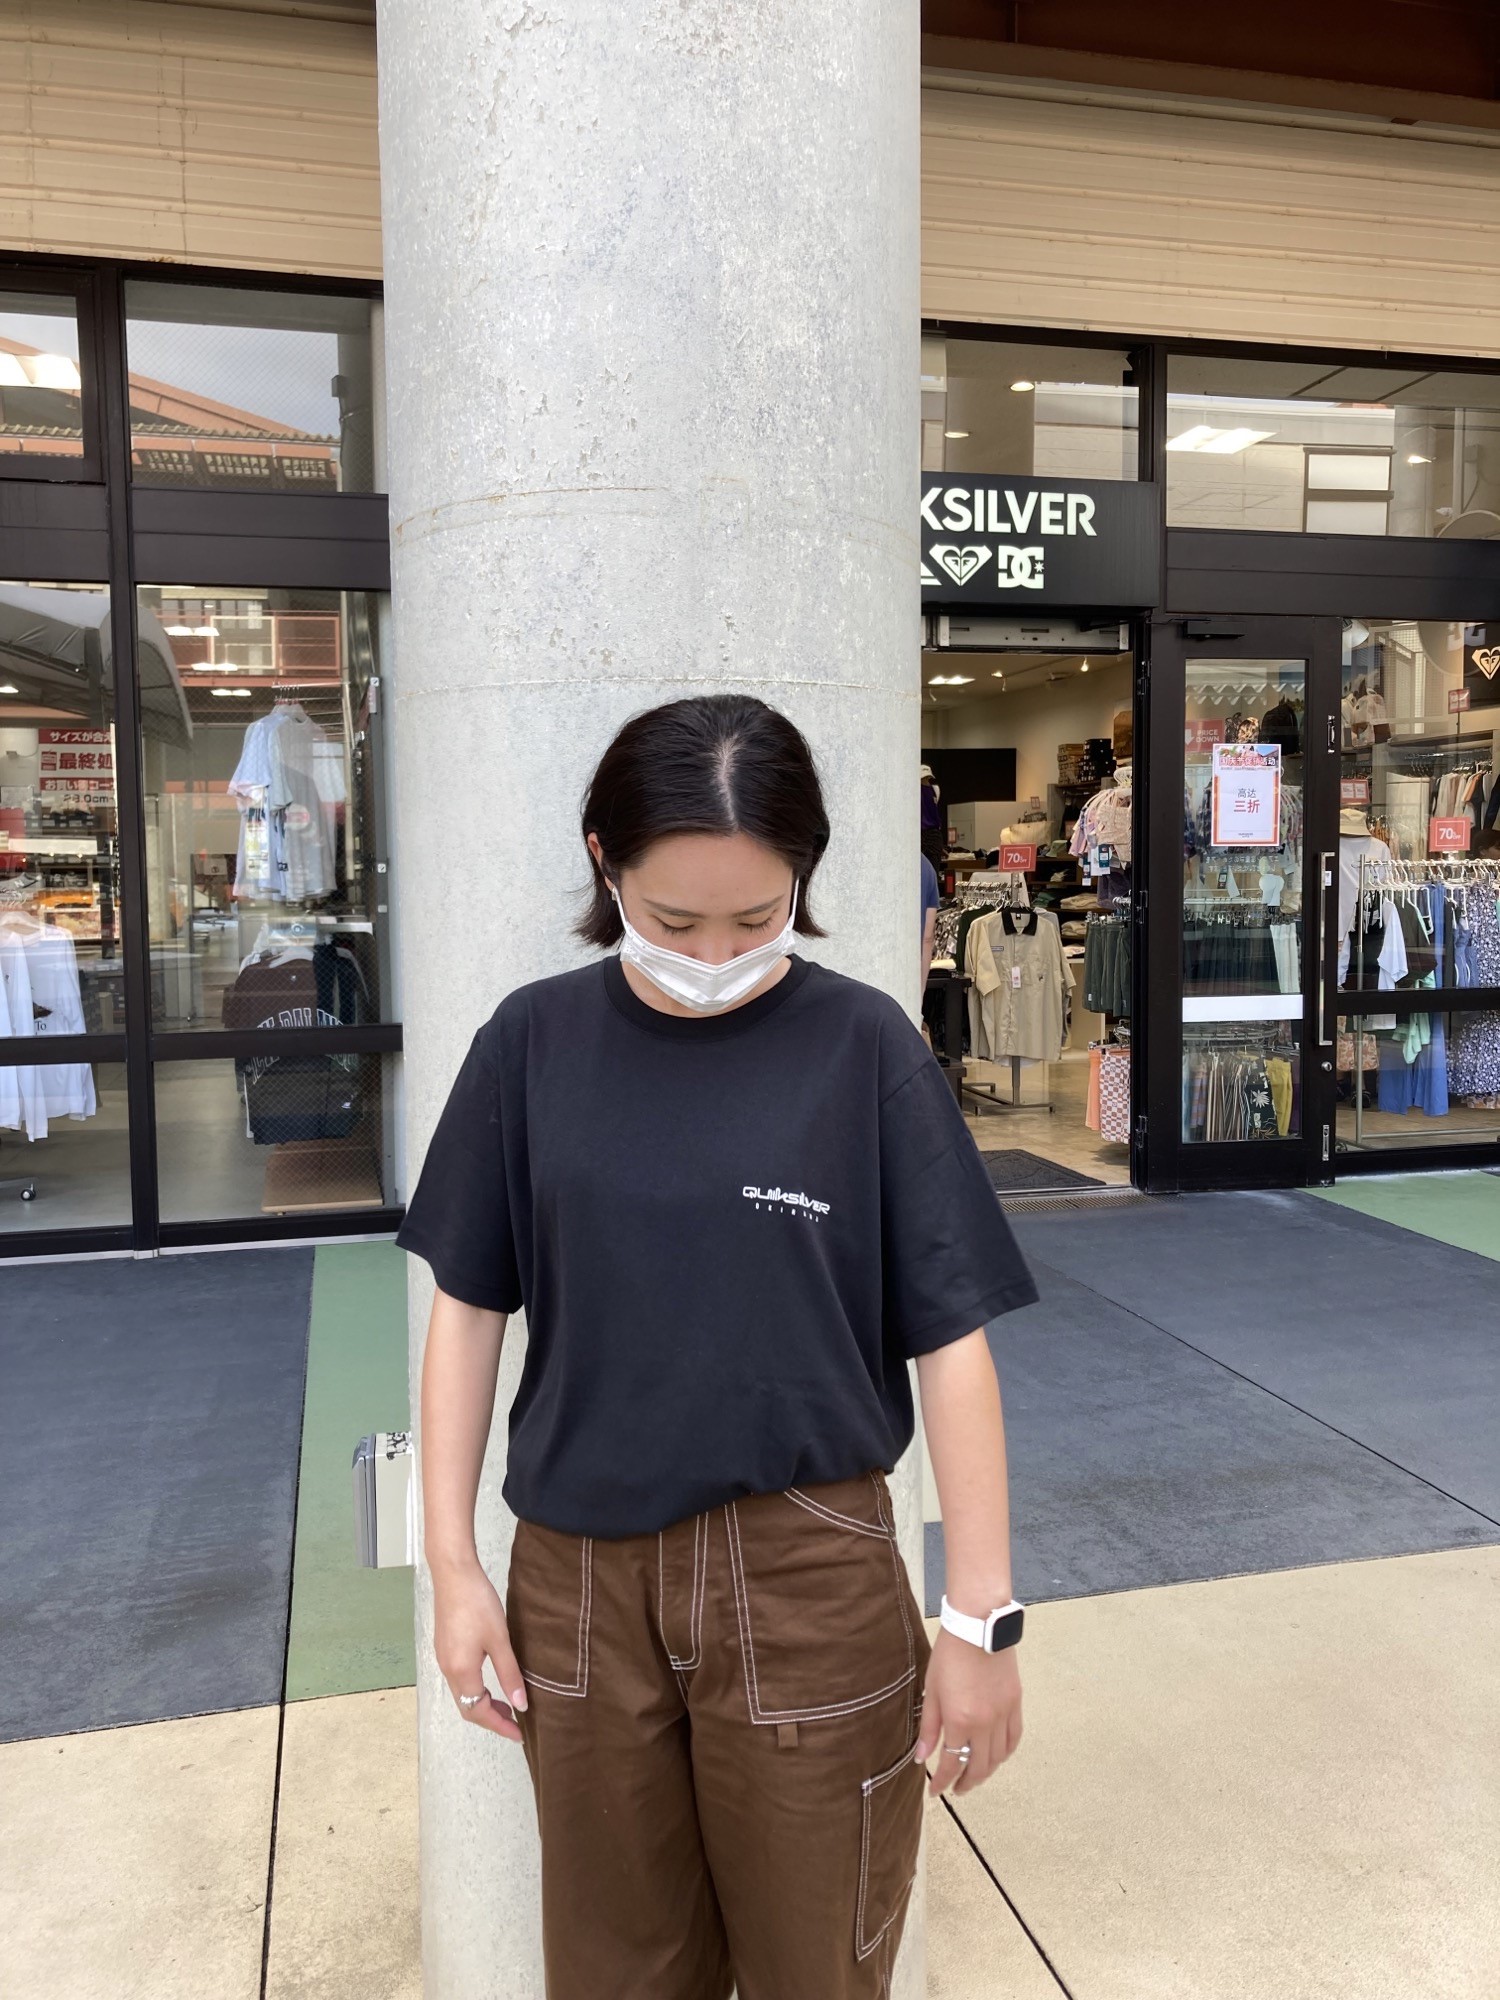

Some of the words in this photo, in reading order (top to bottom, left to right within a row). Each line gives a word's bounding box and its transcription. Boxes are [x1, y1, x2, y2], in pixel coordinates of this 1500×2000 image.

[1238, 788, 1257, 798] 高达
[1233, 799, 1260, 813] 三折
[35, 1021, 47, 1031] To
